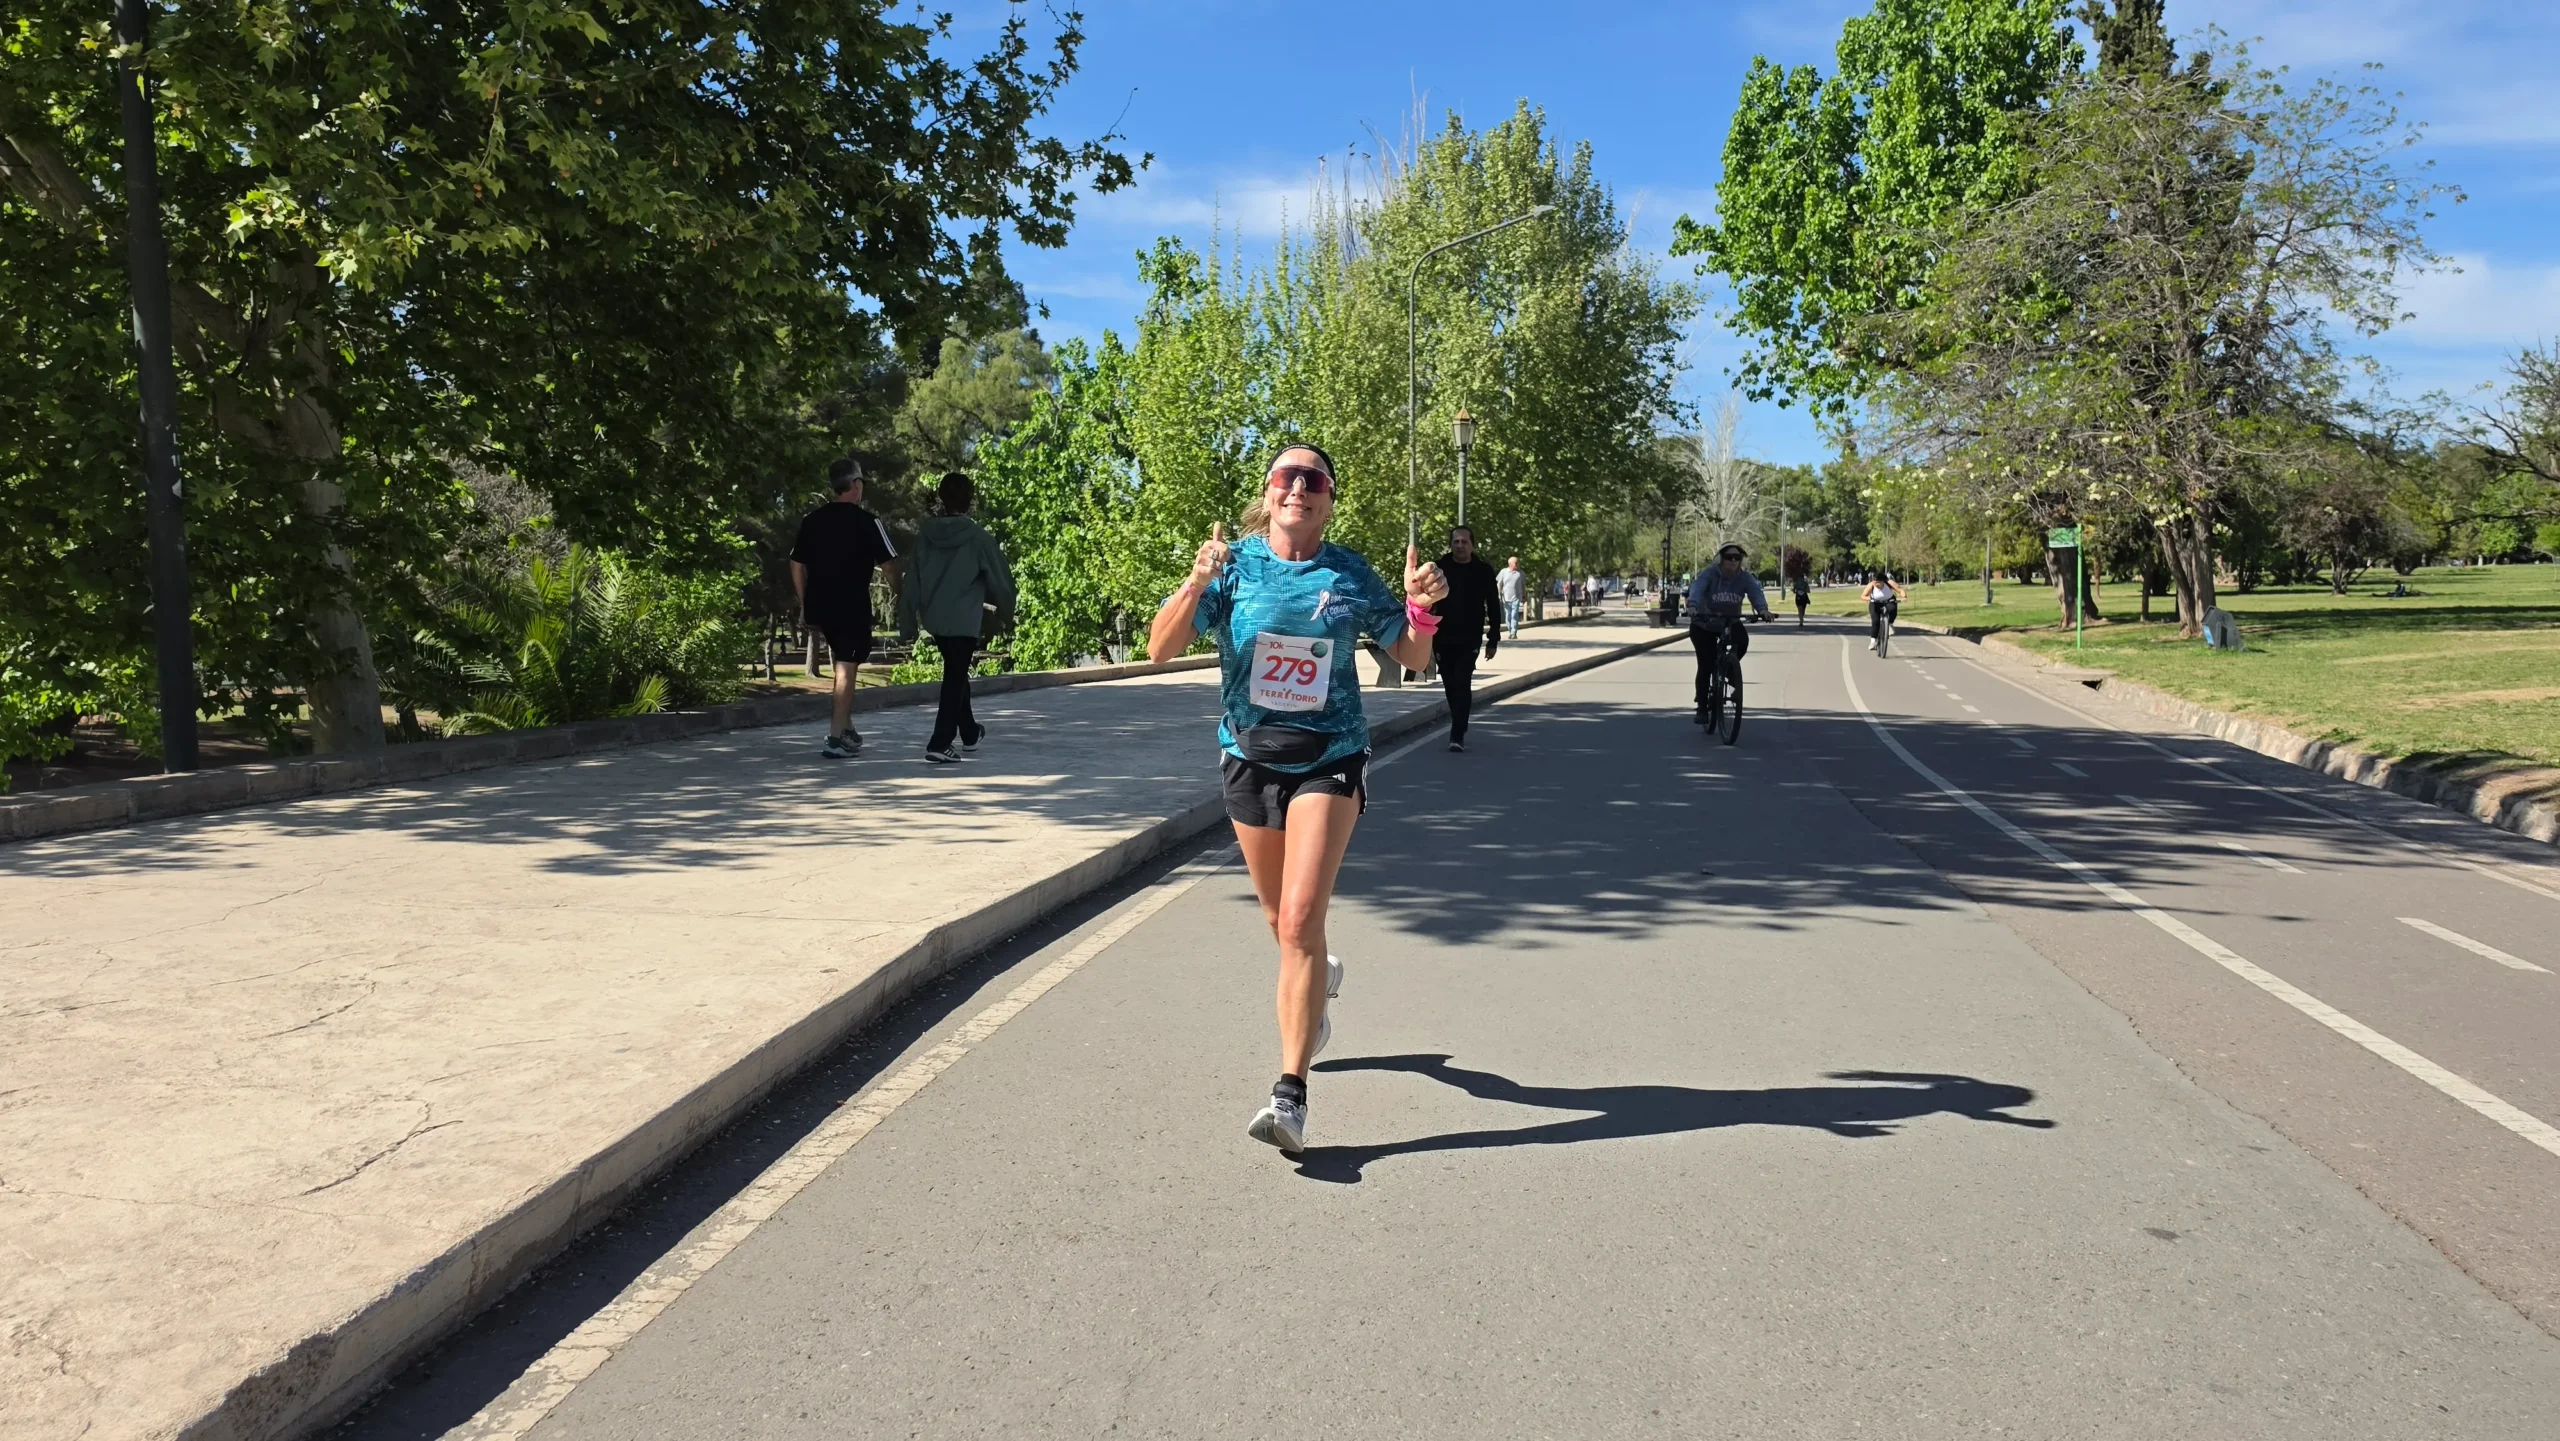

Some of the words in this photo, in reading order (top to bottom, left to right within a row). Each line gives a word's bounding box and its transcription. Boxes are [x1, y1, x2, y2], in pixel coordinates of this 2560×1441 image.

[1269, 641, 1284, 650] 10k
[1261, 655, 1317, 686] 279
[1260, 688, 1318, 703] TERRITORIO
